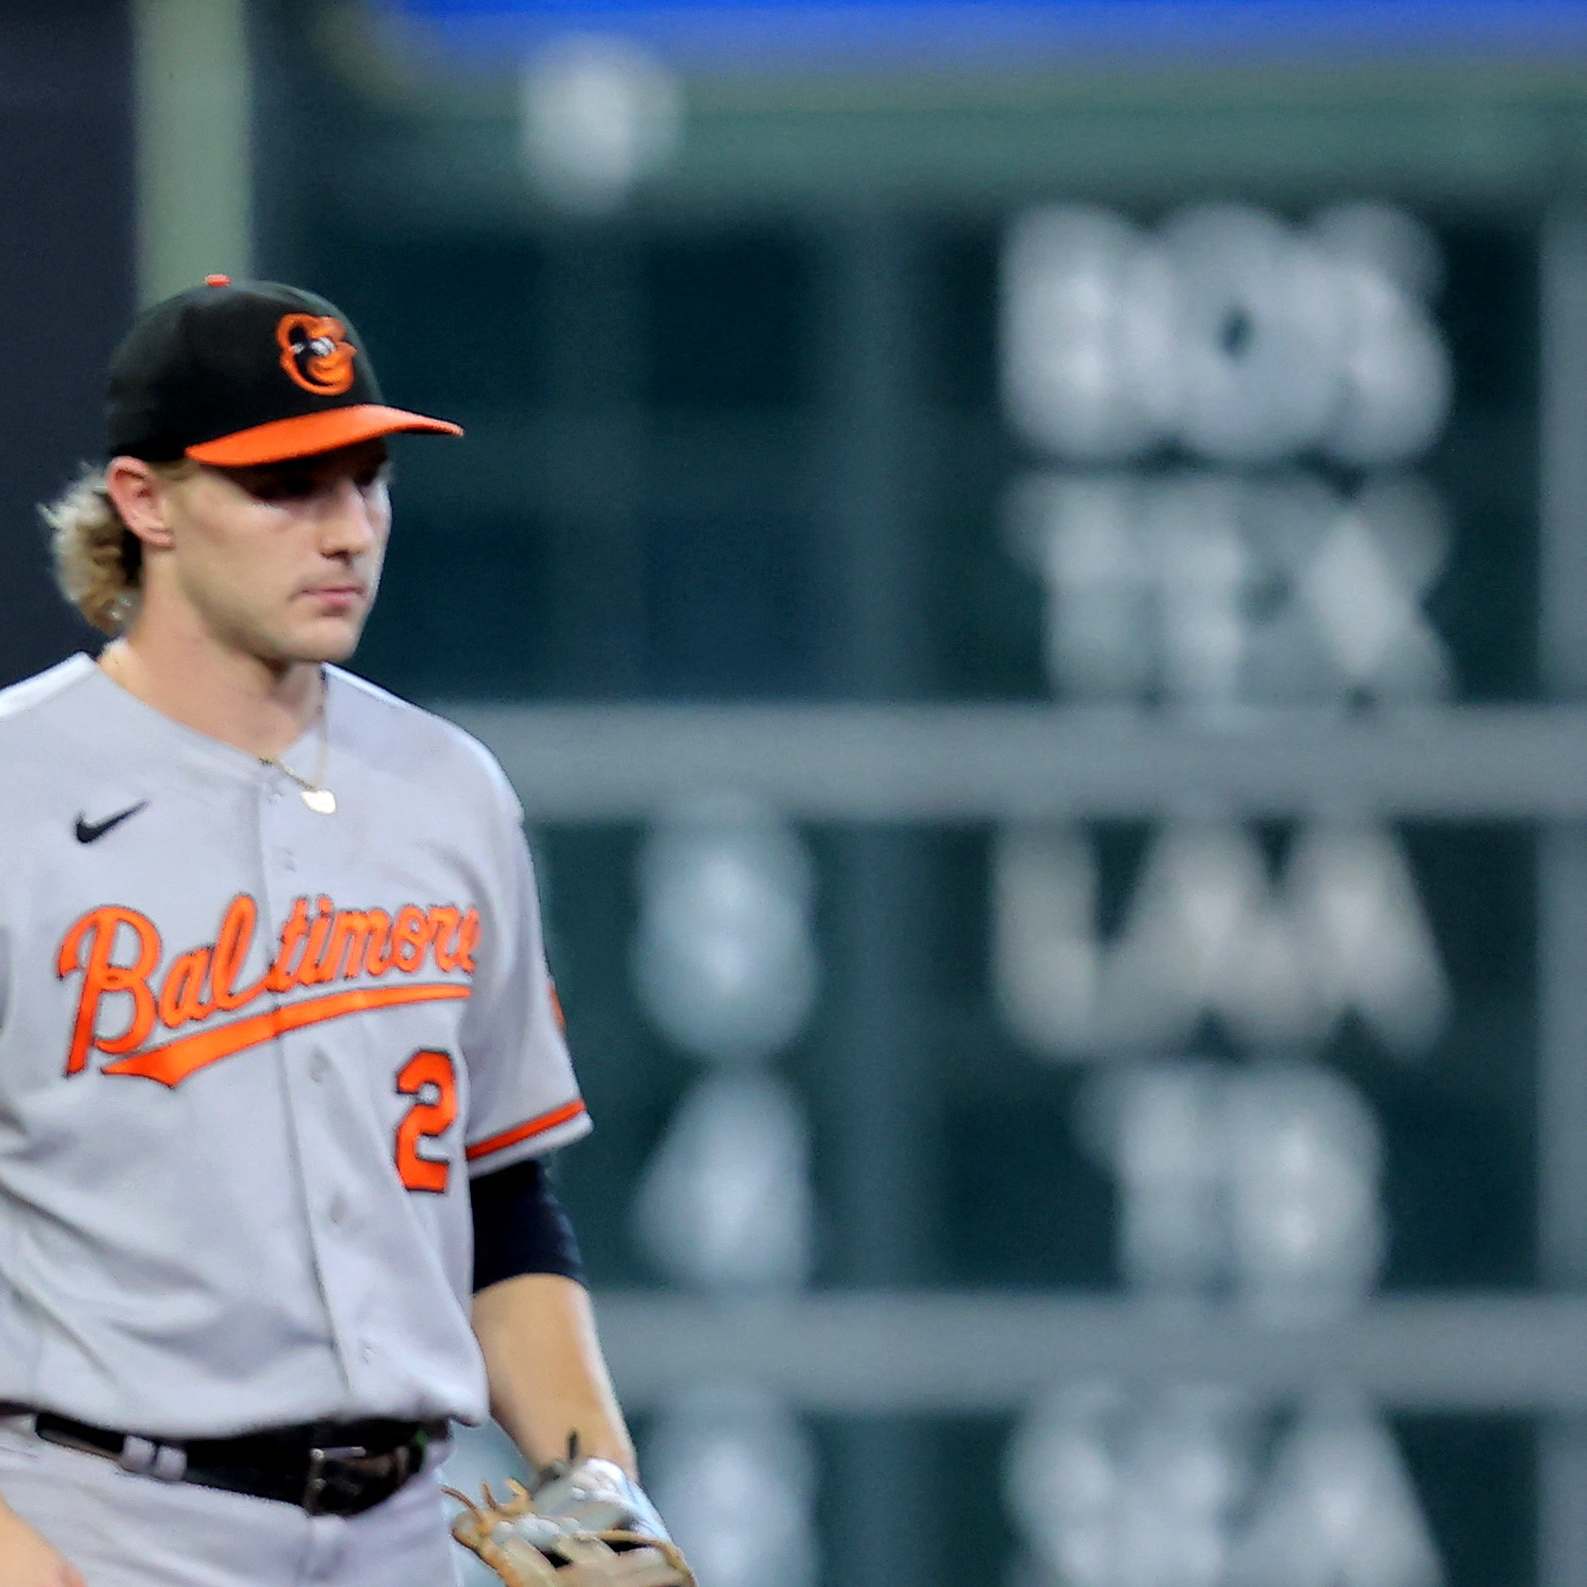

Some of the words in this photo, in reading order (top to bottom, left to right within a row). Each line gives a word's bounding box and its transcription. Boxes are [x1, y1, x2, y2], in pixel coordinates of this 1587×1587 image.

[997, 200, 1454, 462] BOS
[1000, 467, 1457, 728] TEX
[57, 893, 484, 1078] Baltimore
[395, 1048, 459, 1193] 2
